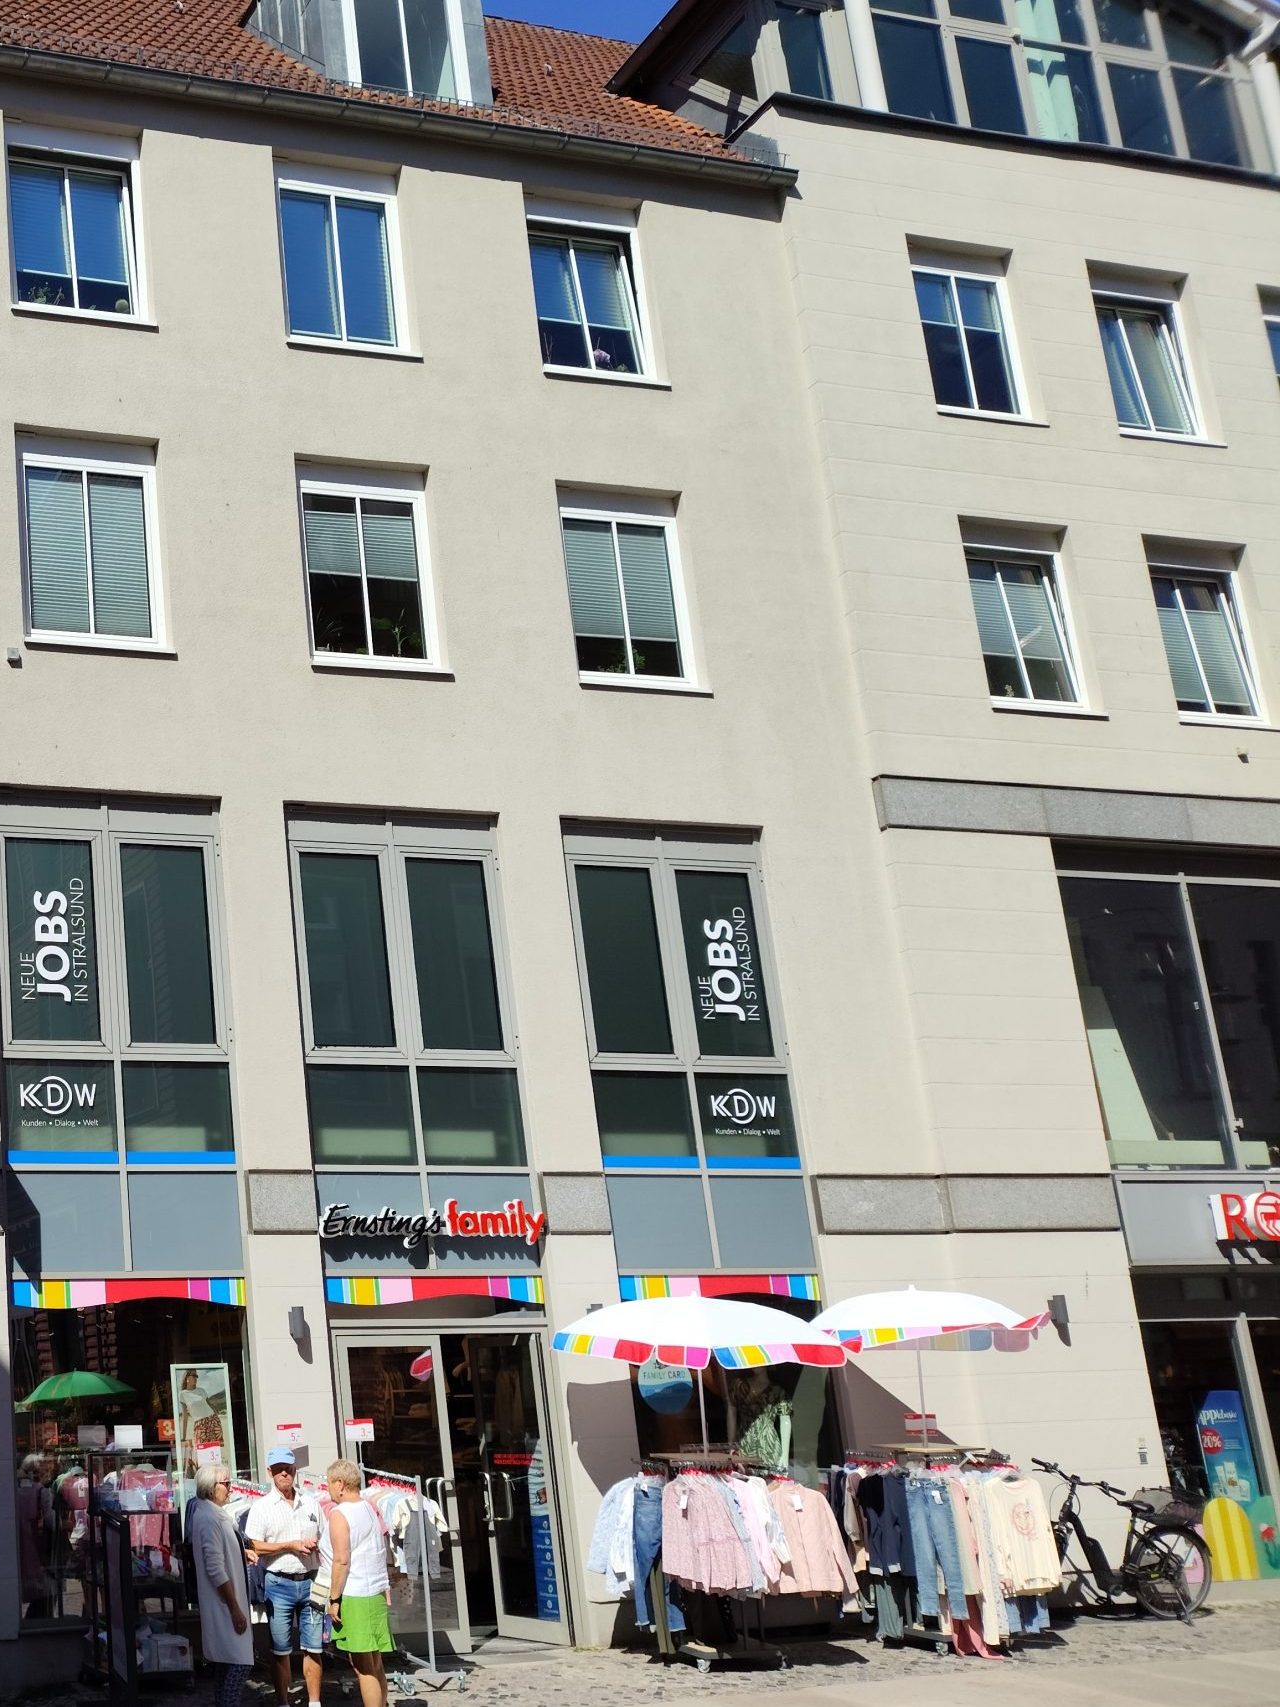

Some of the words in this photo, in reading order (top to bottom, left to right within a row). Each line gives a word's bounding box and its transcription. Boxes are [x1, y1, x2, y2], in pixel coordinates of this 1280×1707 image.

[33, 890, 72, 1002] JOBS
[69, 877, 88, 979] STRALSUND
[703, 918, 746, 1021] JOBS
[732, 906, 757, 1000] STRALSUND
[20, 952, 36, 1000] NEUE
[74, 984, 89, 1002] IN
[697, 975, 716, 1020] NEUE
[746, 1004, 761, 1021] IN
[19, 1075, 97, 1115] KDW
[710, 1088, 776, 1125] KDW
[21, 1119, 47, 1127] Kunden
[54, 1119, 76, 1128] Dialog
[83, 1119, 99, 1127] Welt
[743, 1128, 762, 1136] Dialog
[322, 1203, 441, 1247] Ernsting's
[446, 1199, 545, 1244] family
[1202, 1435, 1222, 1448] 20%
